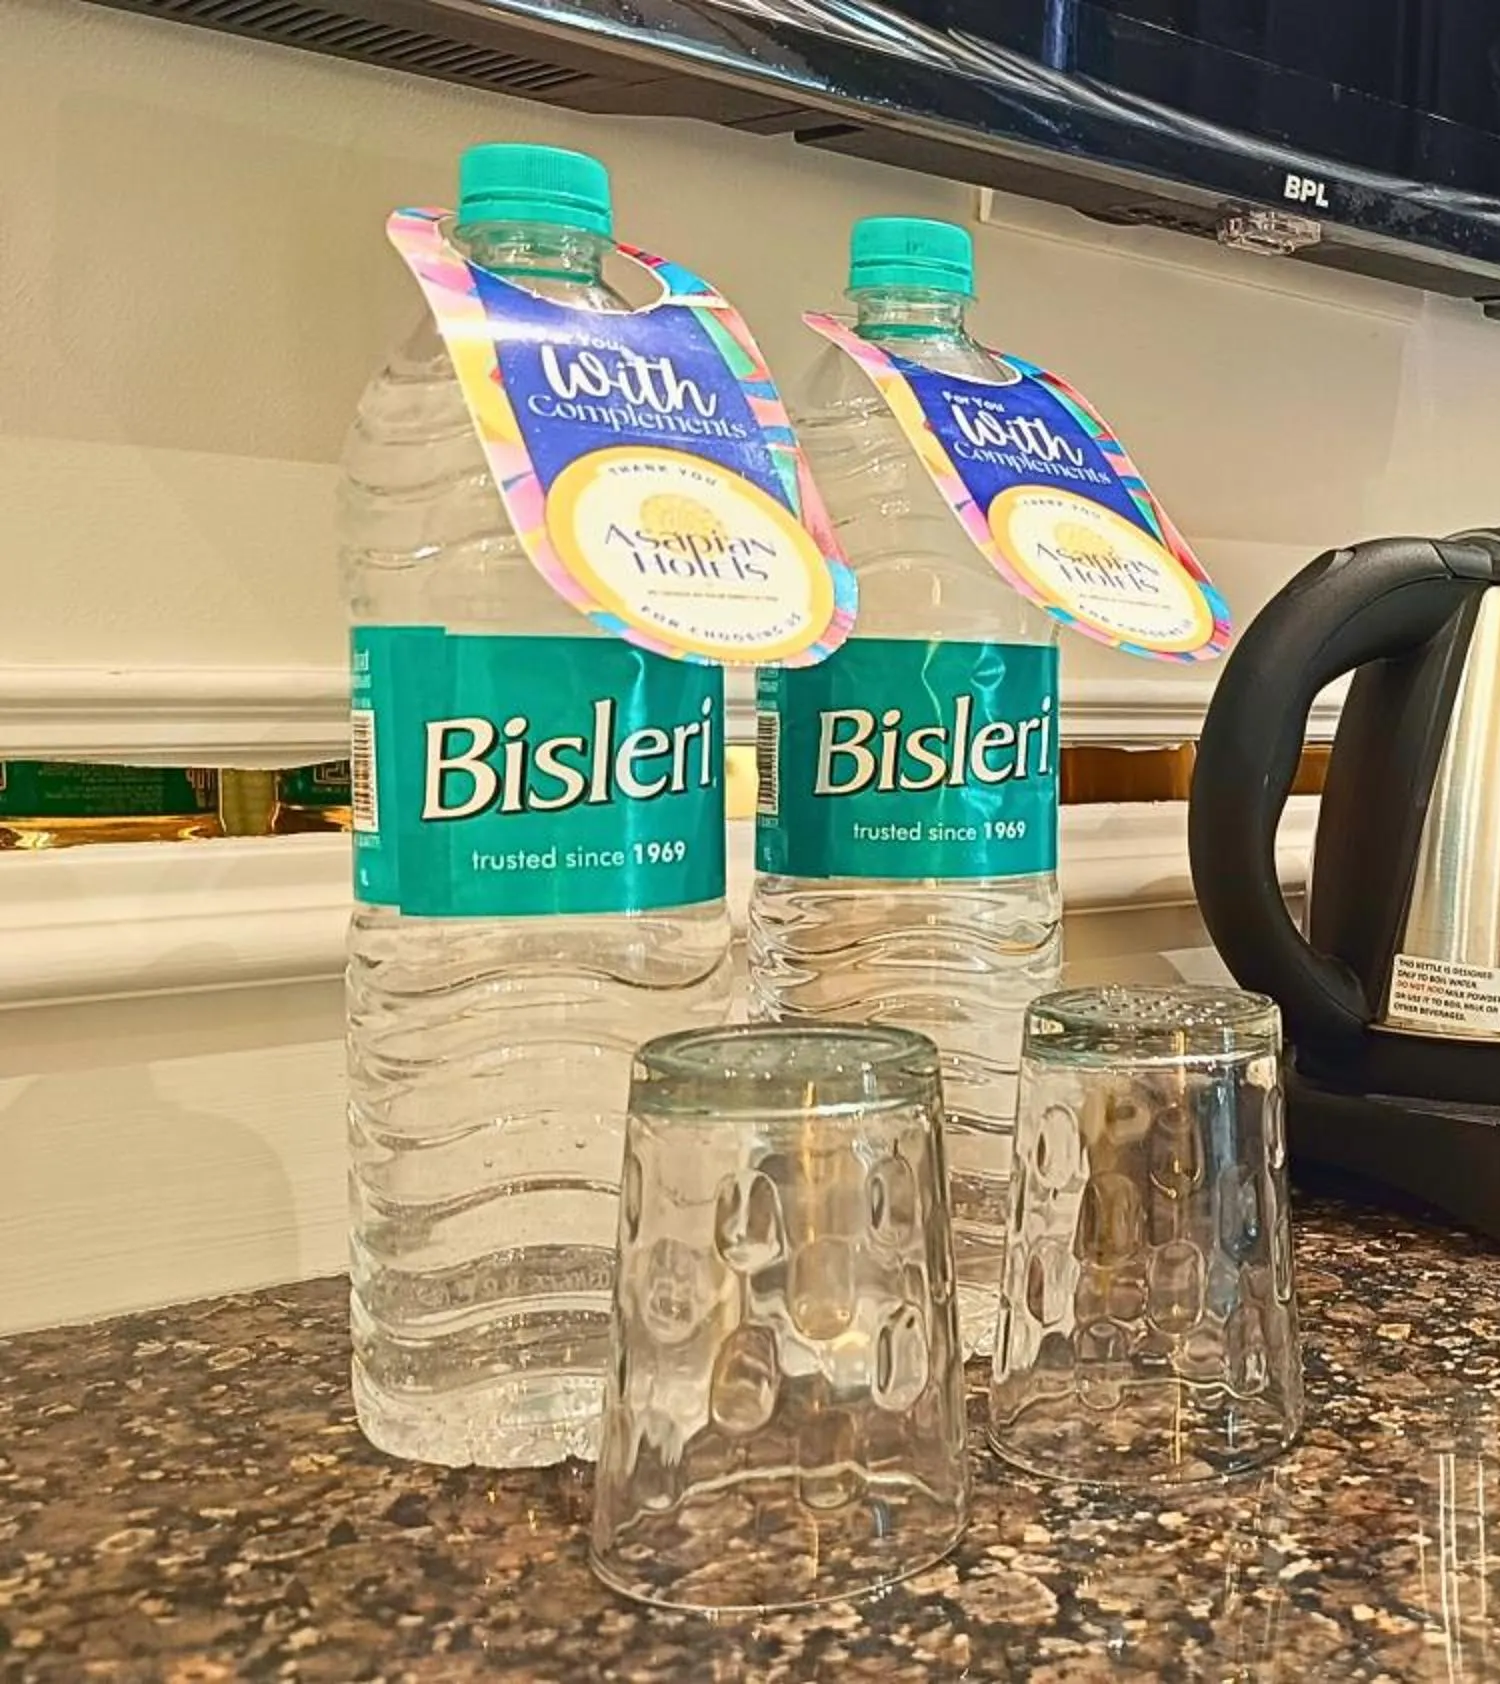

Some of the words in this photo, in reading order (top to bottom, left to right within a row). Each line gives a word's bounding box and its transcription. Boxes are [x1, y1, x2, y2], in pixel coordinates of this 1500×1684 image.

[1283, 173, 1329, 208] BPL
[541, 344, 717, 417] With
[528, 394, 748, 439] Complements
[951, 404, 1083, 467] With
[953, 440, 1112, 485] Complements
[421, 696, 714, 822] Bisleri
[814, 695, 1051, 797] Bisleri
[853, 821, 922, 841] trusted
[928, 822, 977, 841] since
[983, 820, 1026, 839] 1969
[471, 846, 557, 871] trusted
[566, 847, 625, 869] since
[633, 840, 686, 865] 1969
[1410, 982, 1425, 991] NOT
[1416, 961, 1442, 973] KETTLE
